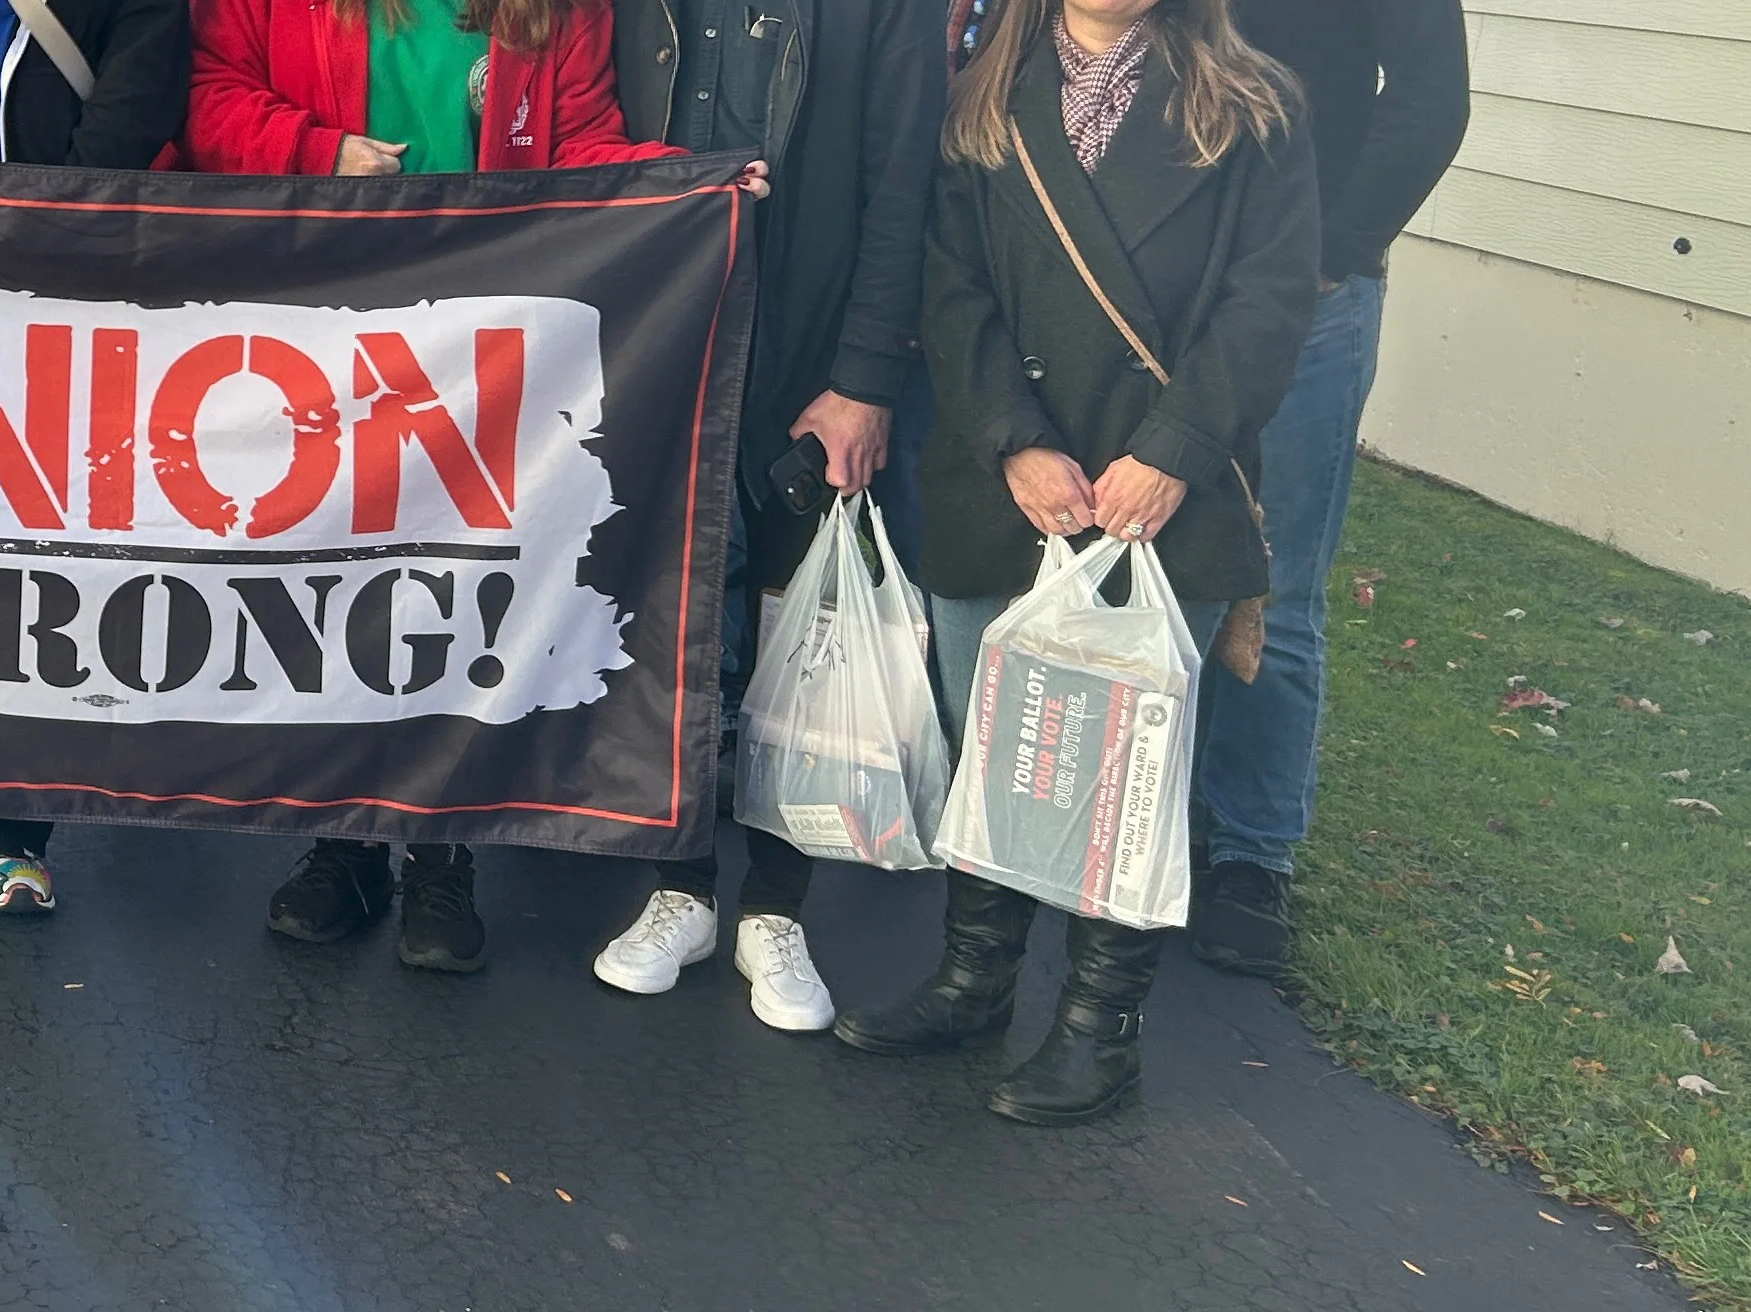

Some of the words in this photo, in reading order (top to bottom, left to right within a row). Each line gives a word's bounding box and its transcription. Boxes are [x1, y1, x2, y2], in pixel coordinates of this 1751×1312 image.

[983, 687, 995, 712] CAN
[1019, 666, 1047, 742] BALLOT.
[978, 714, 992, 741] CITY
[1041, 693, 1064, 746] VOTE.
[1059, 692, 1087, 768] FUTURE.
[1138, 735, 1149, 744] &
[1011, 743, 1035, 794] YOUR
[1033, 750, 1055, 800] YOUR
[1132, 747, 1147, 782] WARD
[1145, 760, 1159, 794] VOTE!
[1053, 769, 1076, 809] OUR
[1127, 785, 1142, 818] YOUR
[1141, 796, 1153, 812] TO
[1124, 821, 1136, 846] OUT
[1134, 816, 1150, 856] WHERE
[1119, 848, 1132, 876] FIND
